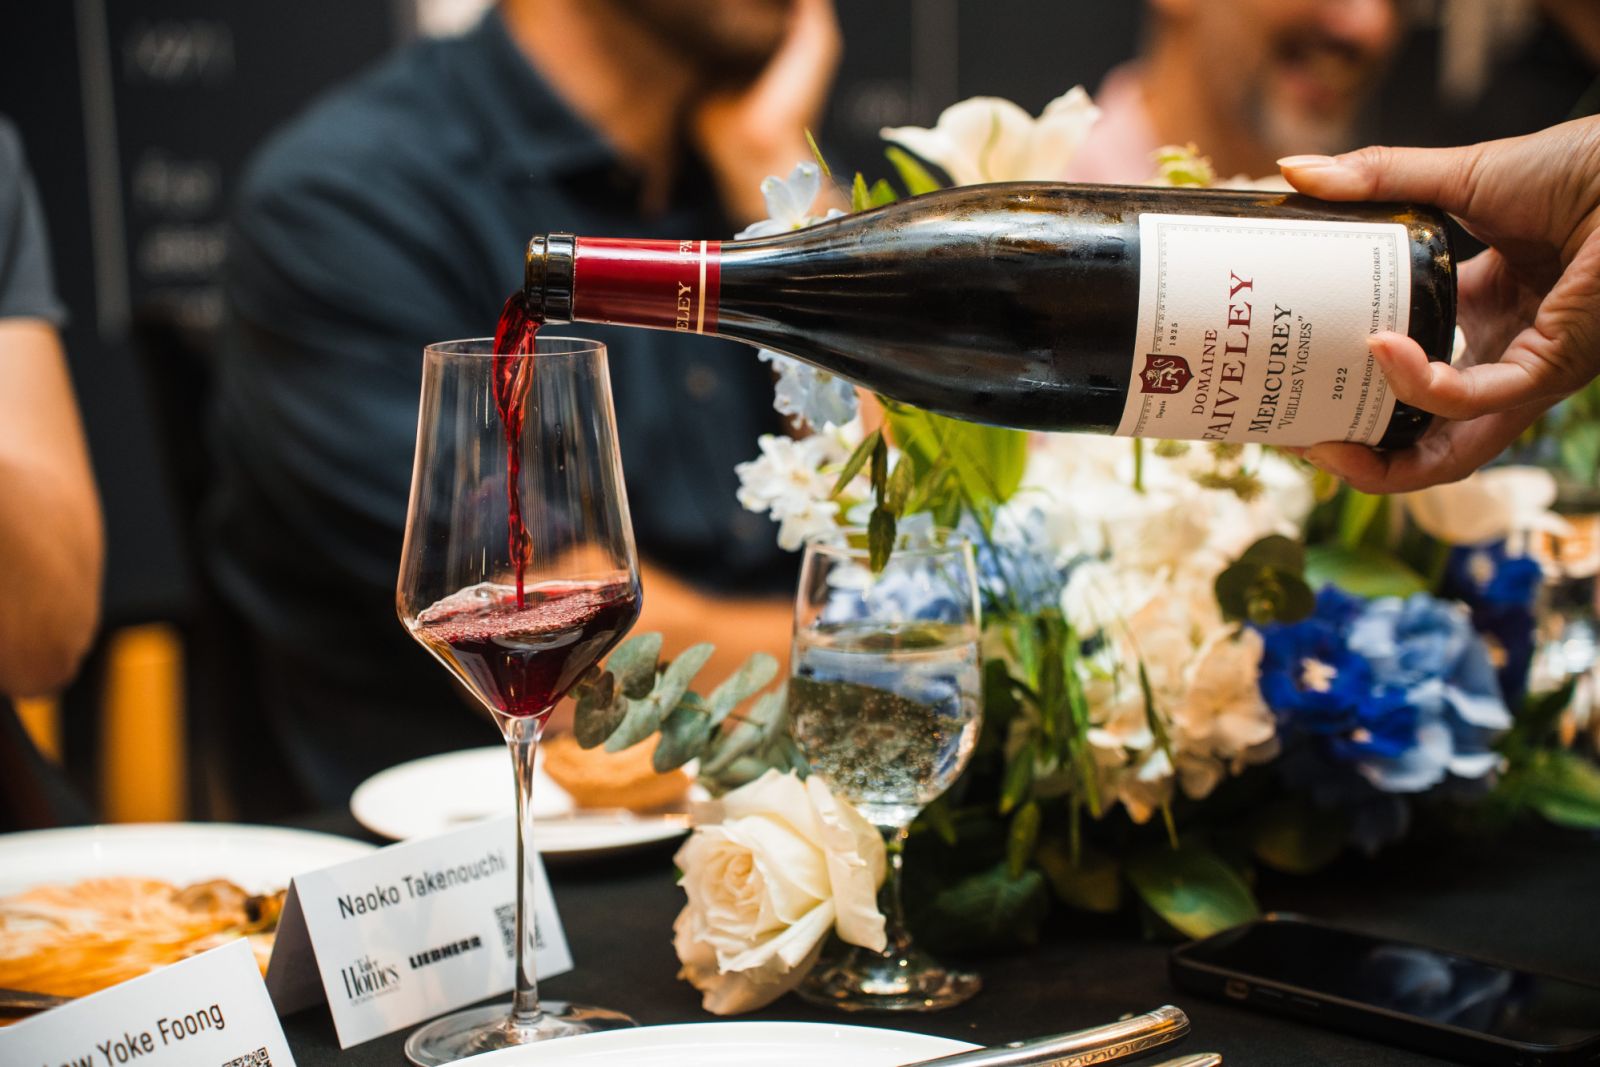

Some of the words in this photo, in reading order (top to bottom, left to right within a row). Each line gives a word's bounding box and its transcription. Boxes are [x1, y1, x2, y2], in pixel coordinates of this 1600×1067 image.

[1169, 322, 1179, 346] 1825
[1201, 269, 1253, 440] FAIVELEY
[1248, 303, 1292, 433] MERCUREY
[1192, 329, 1218, 415] DOMAINE
[1332, 367, 1348, 400] 2022
[337, 885, 400, 919] Naoko
[402, 850, 507, 898] Takenouchi
[96, 1032, 154, 1067] Yoke
[157, 1003, 225, 1045] Foong
